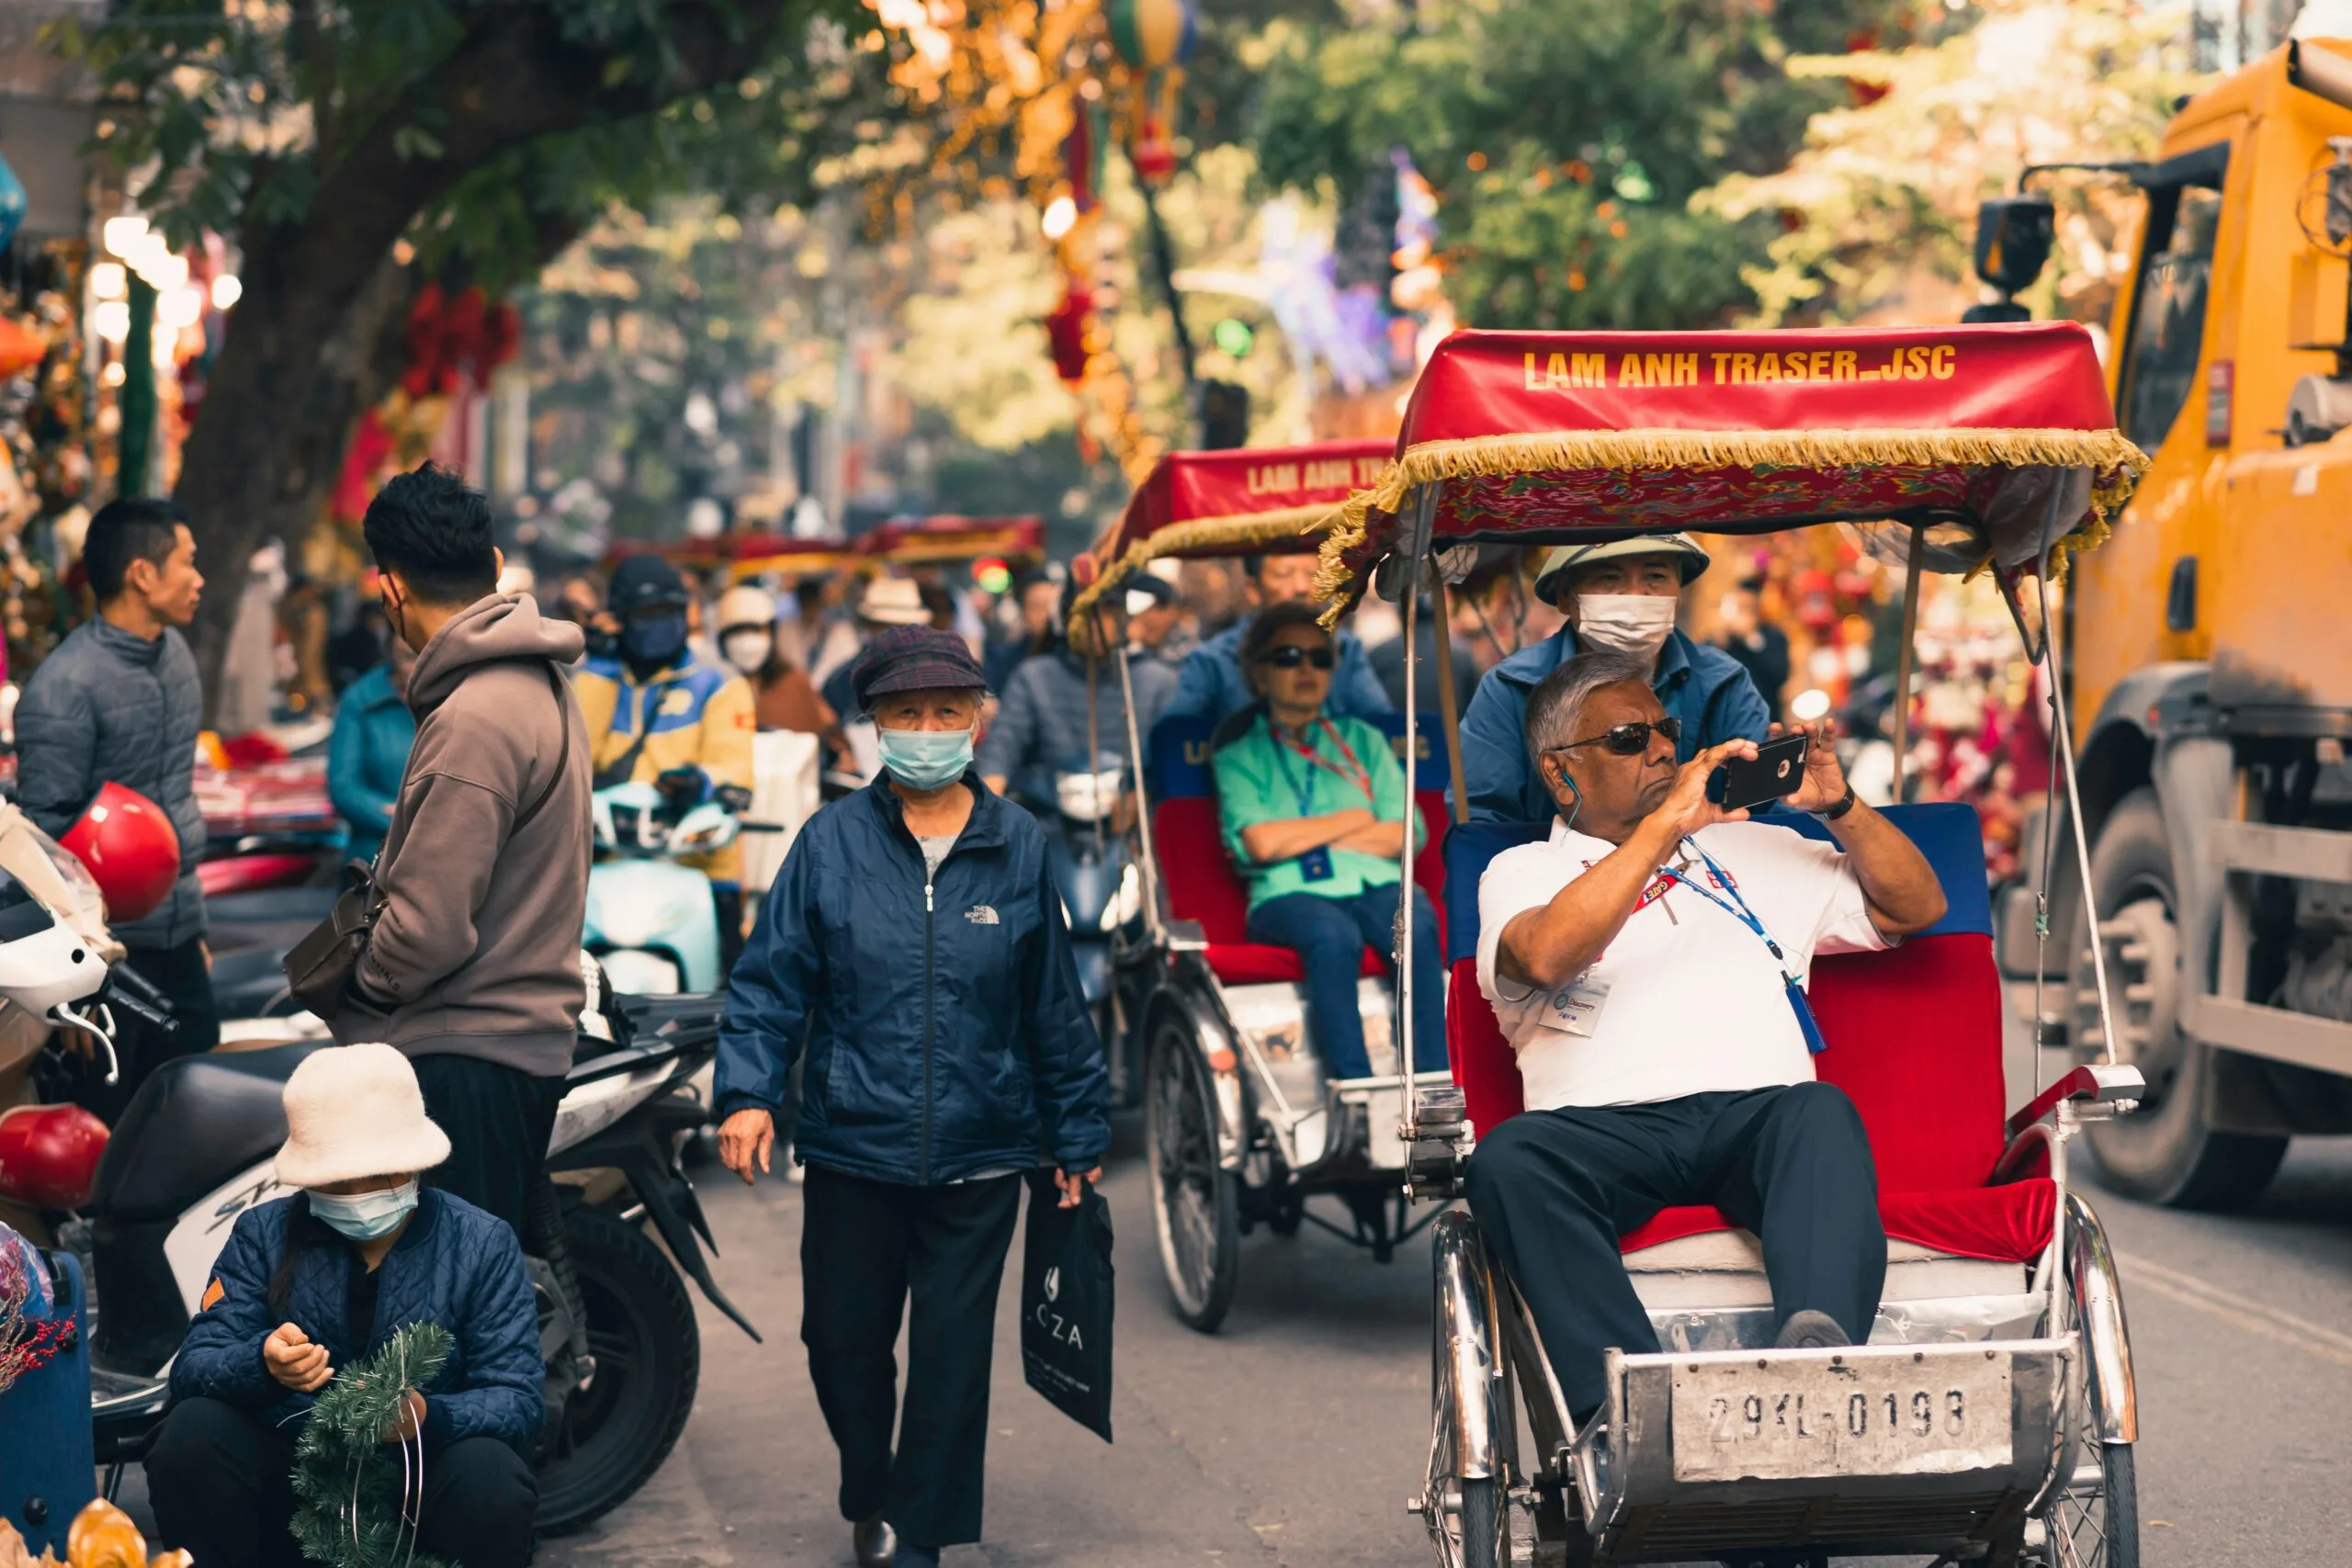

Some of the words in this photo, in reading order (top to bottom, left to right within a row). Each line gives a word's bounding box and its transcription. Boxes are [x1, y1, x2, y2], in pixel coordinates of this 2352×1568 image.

[1524, 353, 1606, 391] LAM
[1618, 352, 1698, 389] ANH
[1248, 464, 1298, 494] LAM
[1304, 459, 1353, 490] ANH
[1647, 879, 1668, 900] GATE
